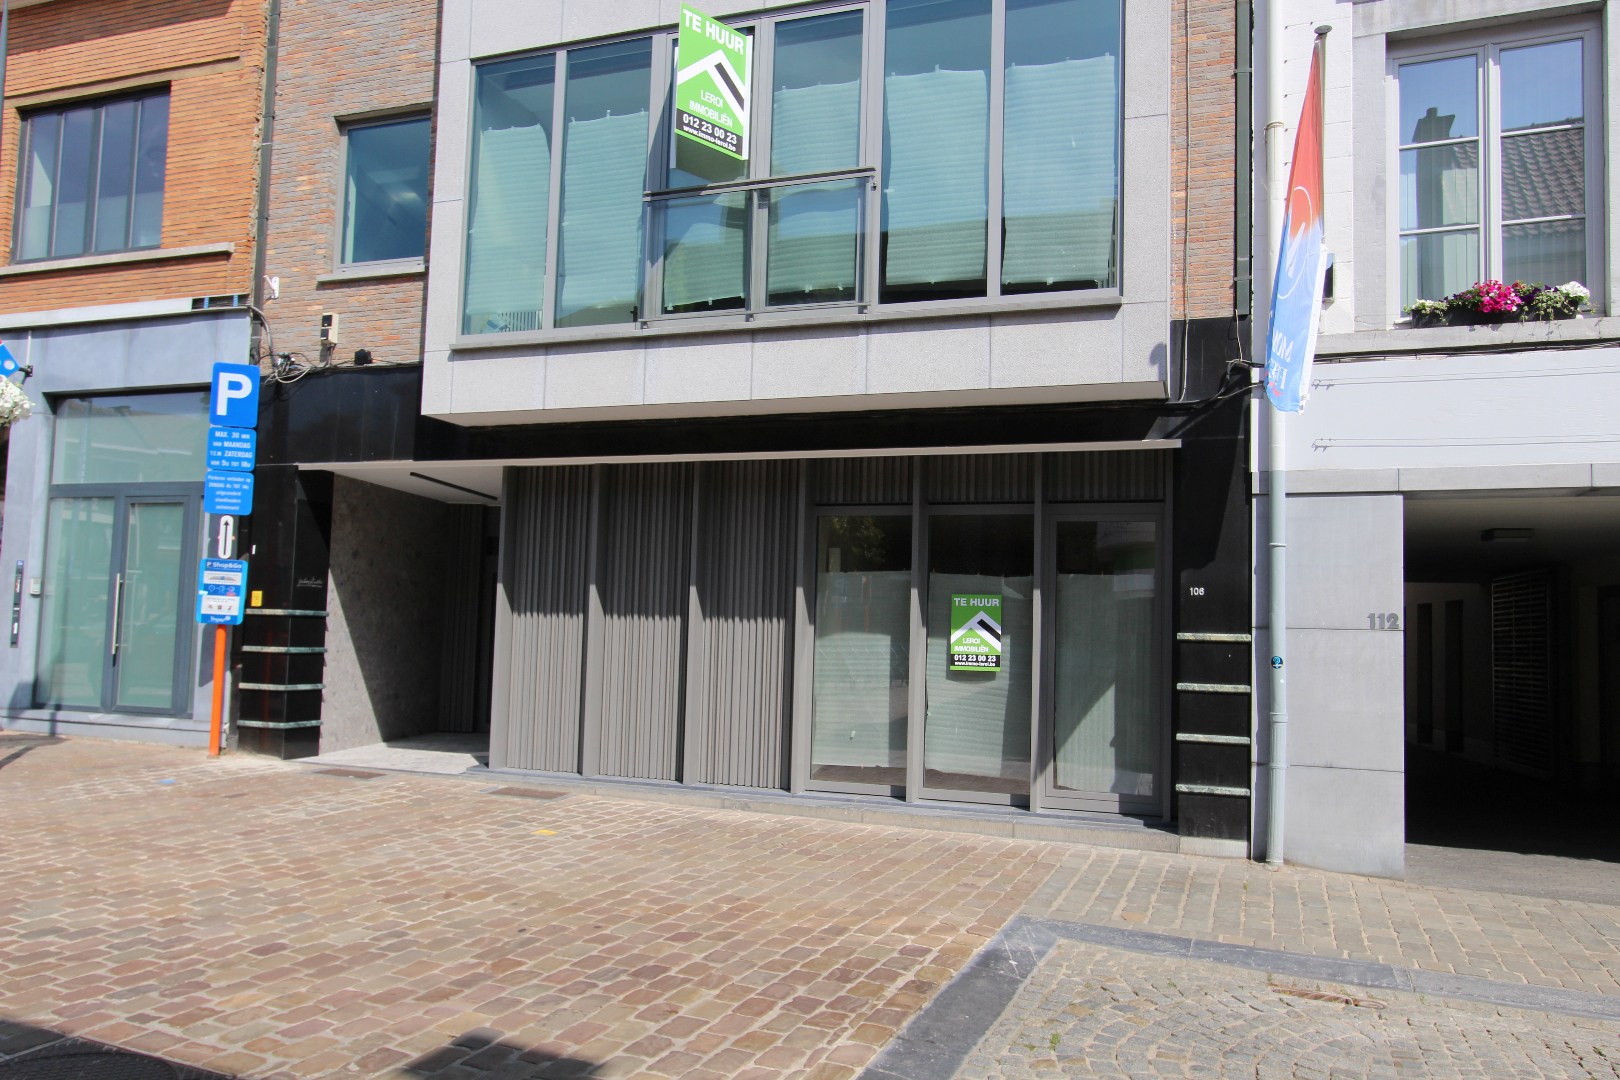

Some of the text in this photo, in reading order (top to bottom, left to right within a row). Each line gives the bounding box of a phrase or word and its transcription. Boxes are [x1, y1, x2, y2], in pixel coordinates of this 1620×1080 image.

[683, 9, 744, 55] TE HUUR
[700, 90, 723, 108] LEROI
[689, 99, 733, 128] IMMOBILIËN
[683, 114, 737, 144] 012 23 00 23
[683, 125, 737, 151] www.immo-leroi.be
[216, 372, 252, 416] P
[223, 441, 251, 449] MAANDAG
[224, 450, 253, 458] ZATERDAG
[954, 598, 1000, 607] TE HUUR
[1366, 612, 1399, 630] 112
